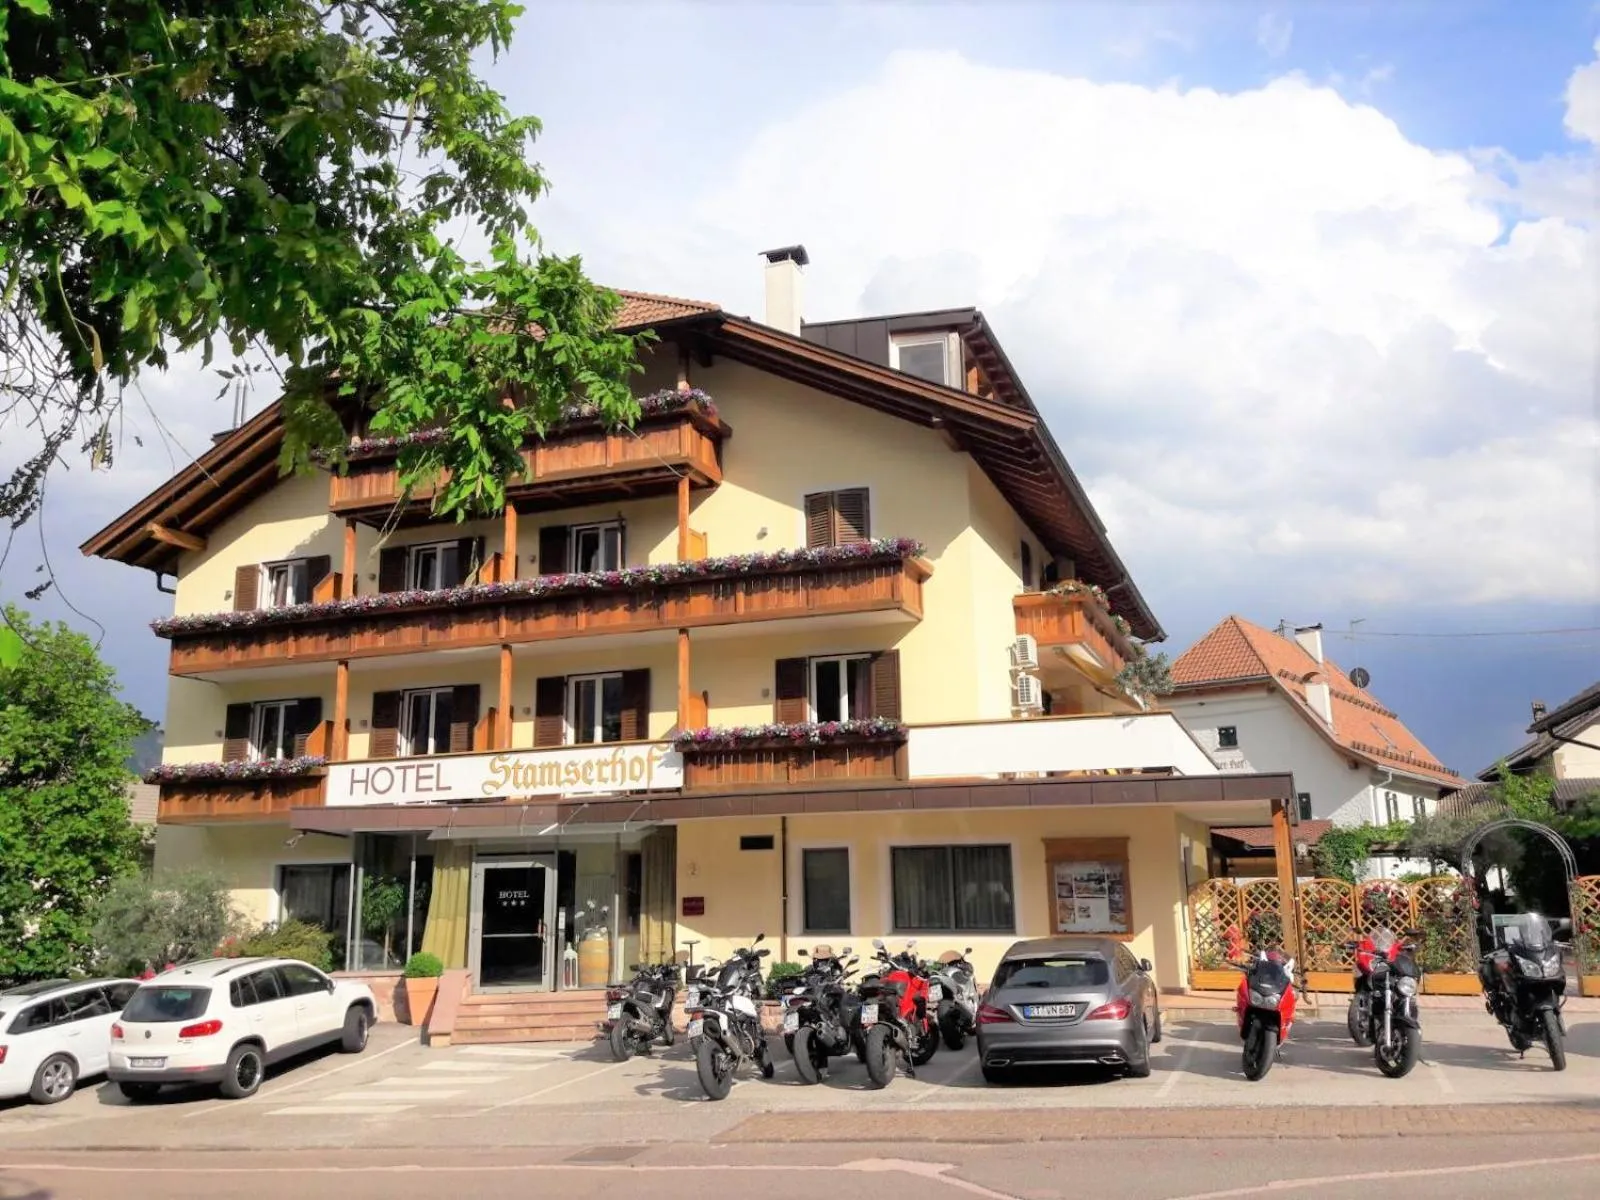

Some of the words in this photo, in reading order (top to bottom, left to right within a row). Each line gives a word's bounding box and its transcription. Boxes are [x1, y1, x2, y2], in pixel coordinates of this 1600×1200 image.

[349, 763, 452, 796] HOTEL
[481, 745, 670, 796] Stamserhof
[498, 890, 530, 899] HOTEL
